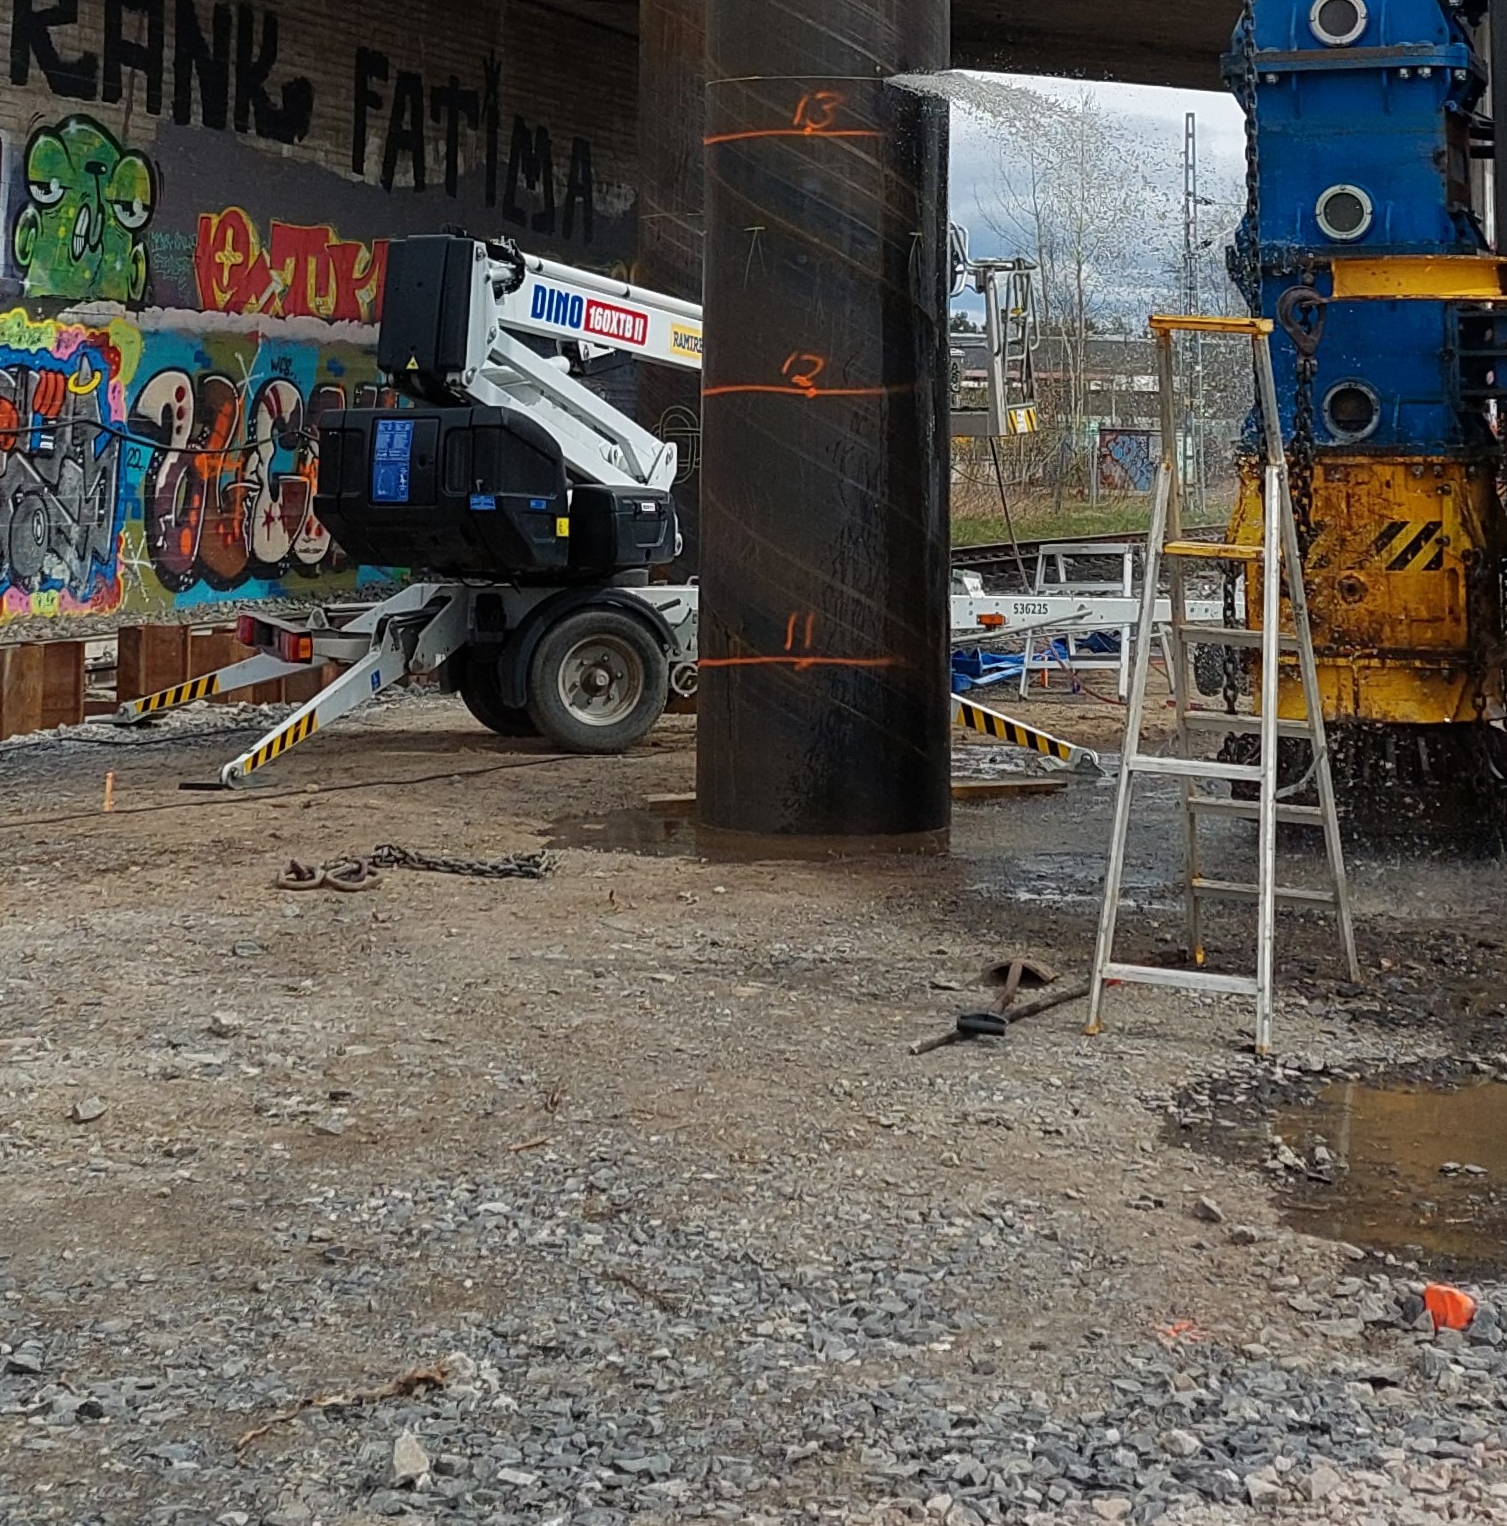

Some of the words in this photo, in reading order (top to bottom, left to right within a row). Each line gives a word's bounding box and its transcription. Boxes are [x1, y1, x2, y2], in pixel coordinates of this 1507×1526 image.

[794, 92, 839, 129] 13
[531, 284, 584, 330] DINO
[588, 305, 633, 338] 160XTB
[782, 354, 824, 385] 12
[785, 612, 816, 650] 11
